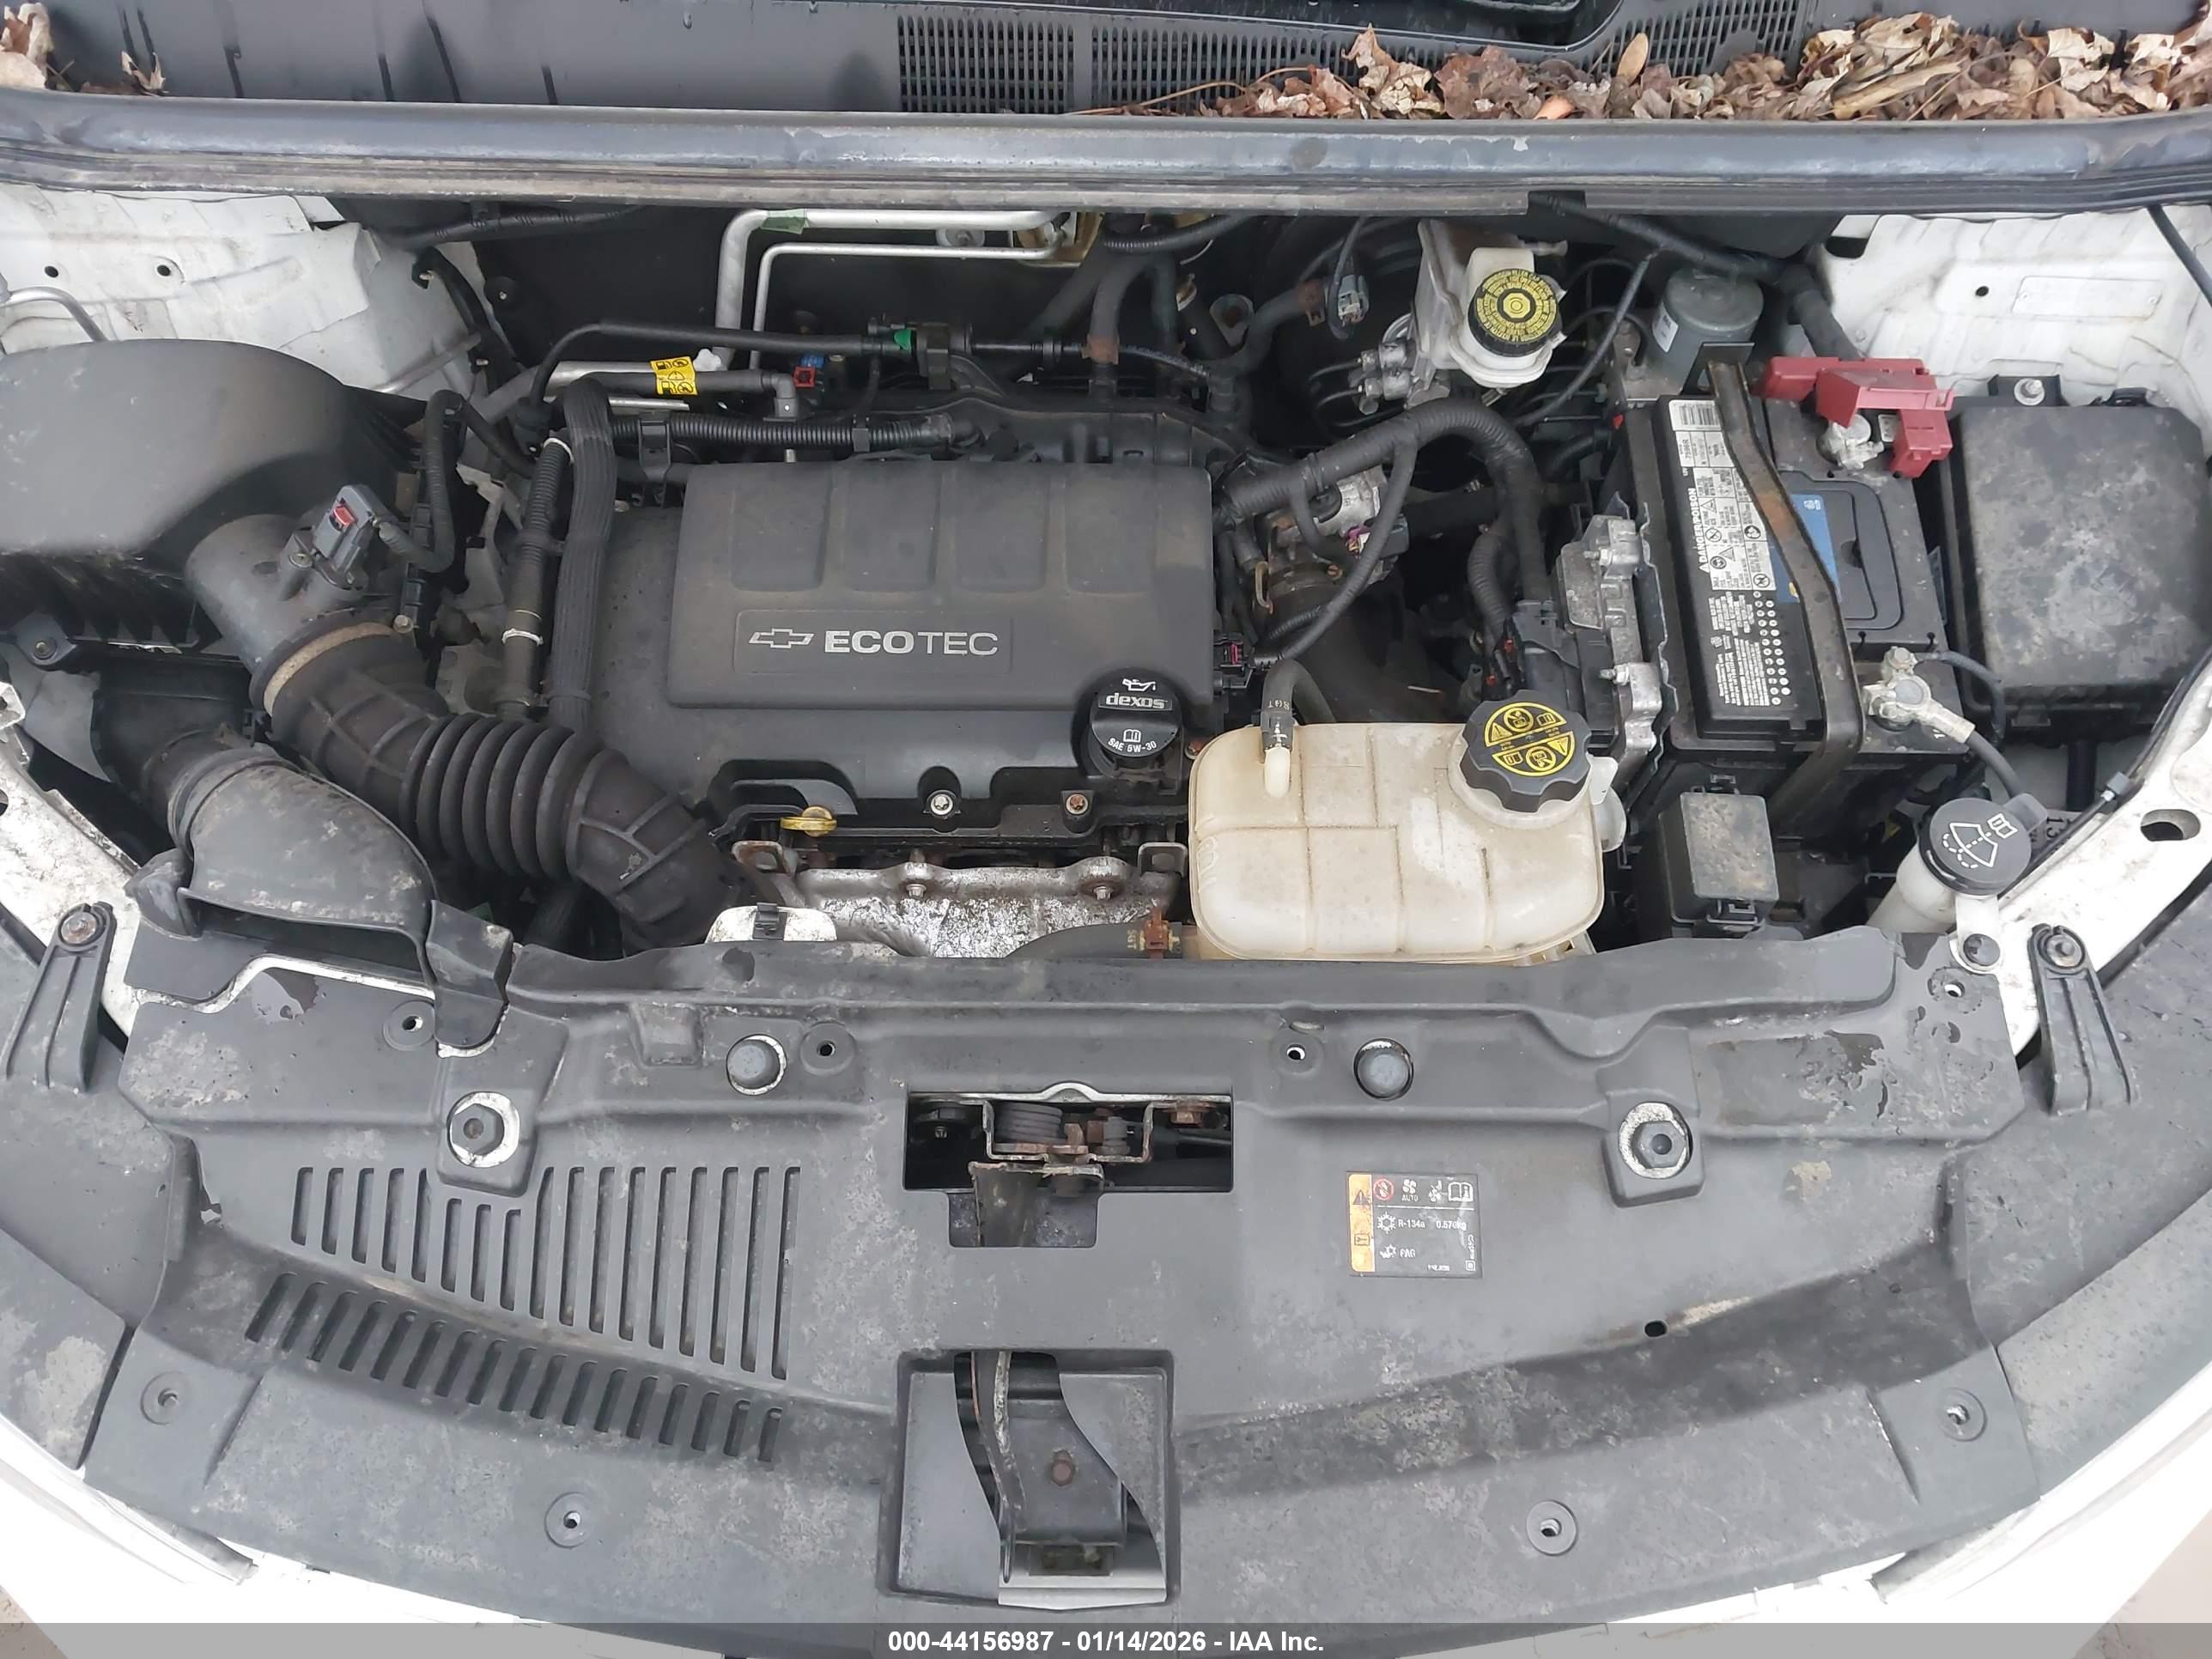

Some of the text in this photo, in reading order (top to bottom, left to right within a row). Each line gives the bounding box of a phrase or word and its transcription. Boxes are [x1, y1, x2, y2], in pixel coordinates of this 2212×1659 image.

[1687, 488, 1708, 562] DANGER/POISON
[823, 630, 999, 655] ECOTEC
[1105, 692, 1165, 709] dexos
[1108, 738, 1158, 753] SAE 5W-30
[1398, 1219, 1467, 1231] R-134a 0.570kg
